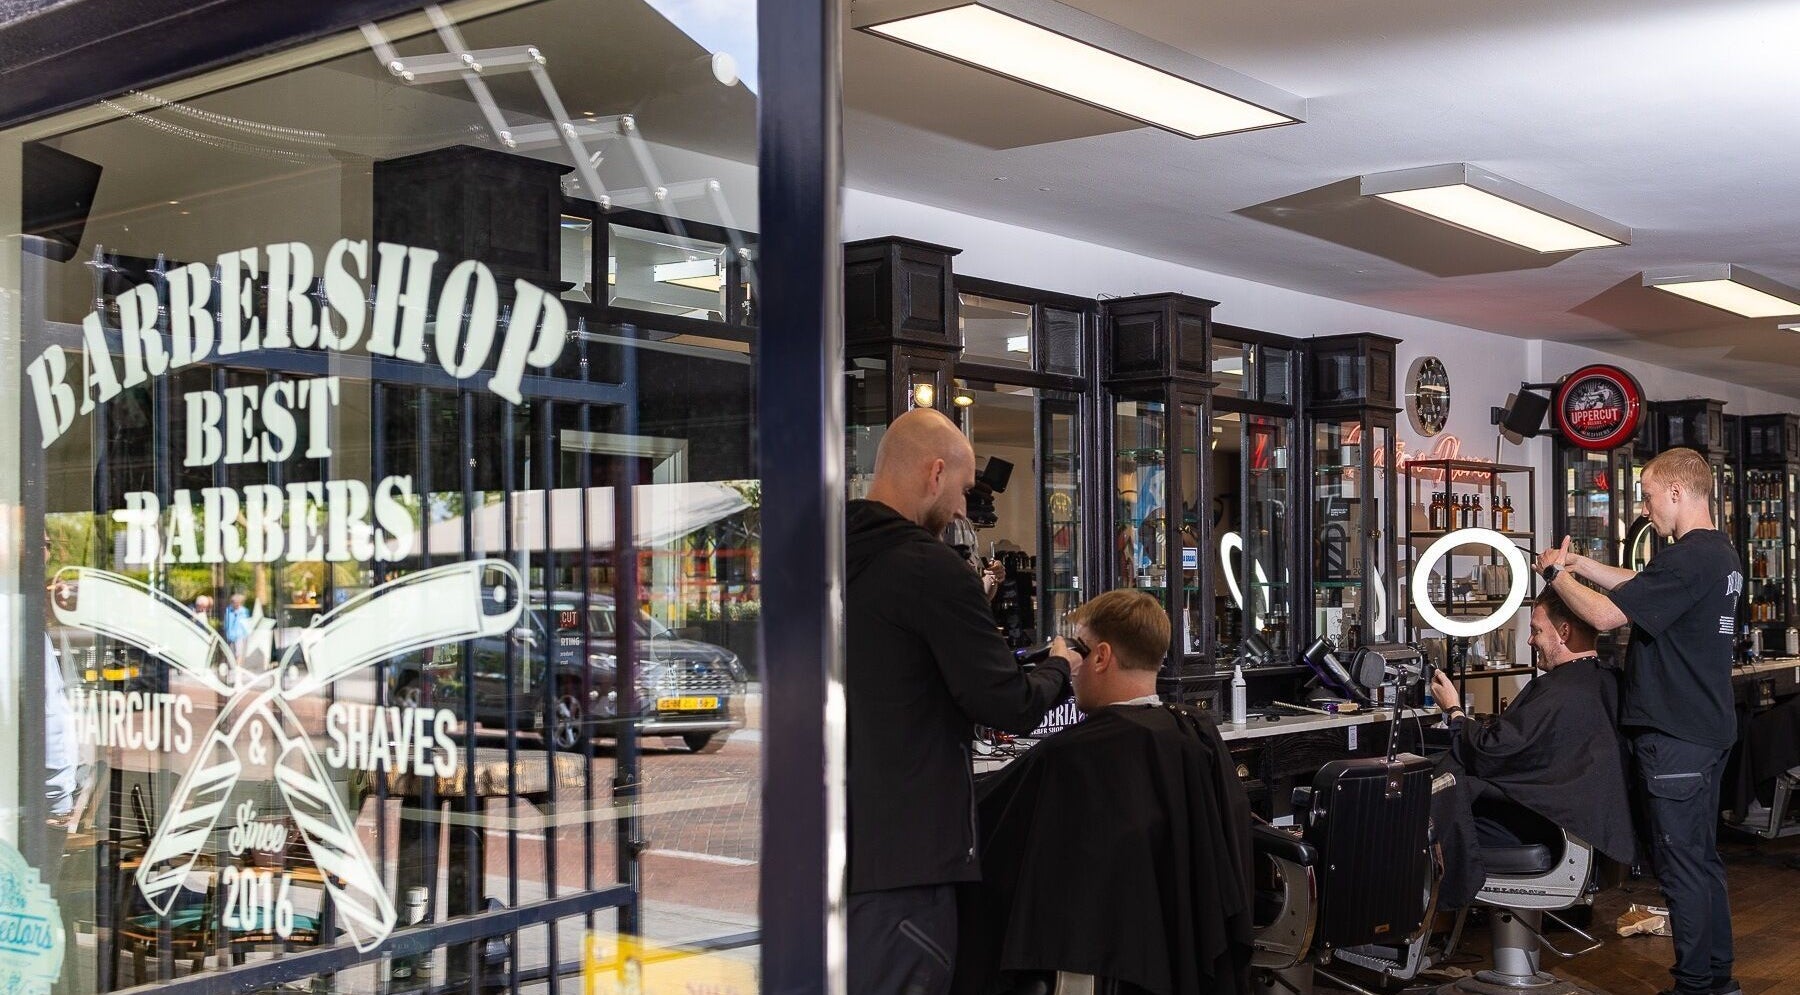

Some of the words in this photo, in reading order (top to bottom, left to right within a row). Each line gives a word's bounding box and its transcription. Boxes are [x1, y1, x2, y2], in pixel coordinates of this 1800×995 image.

[26, 237, 568, 449] BARBERSHOP
[182, 376, 340, 468] BEST
[1570, 408, 1619, 425] UPPERCUT
[122, 475, 416, 564] BARBERS
[69, 690, 194, 755] HAIRCUTS
[248, 719, 268, 765] &
[326, 703, 458, 778] SHAVES
[228, 799, 289, 856] Since
[222, 866, 294, 938] 2016
